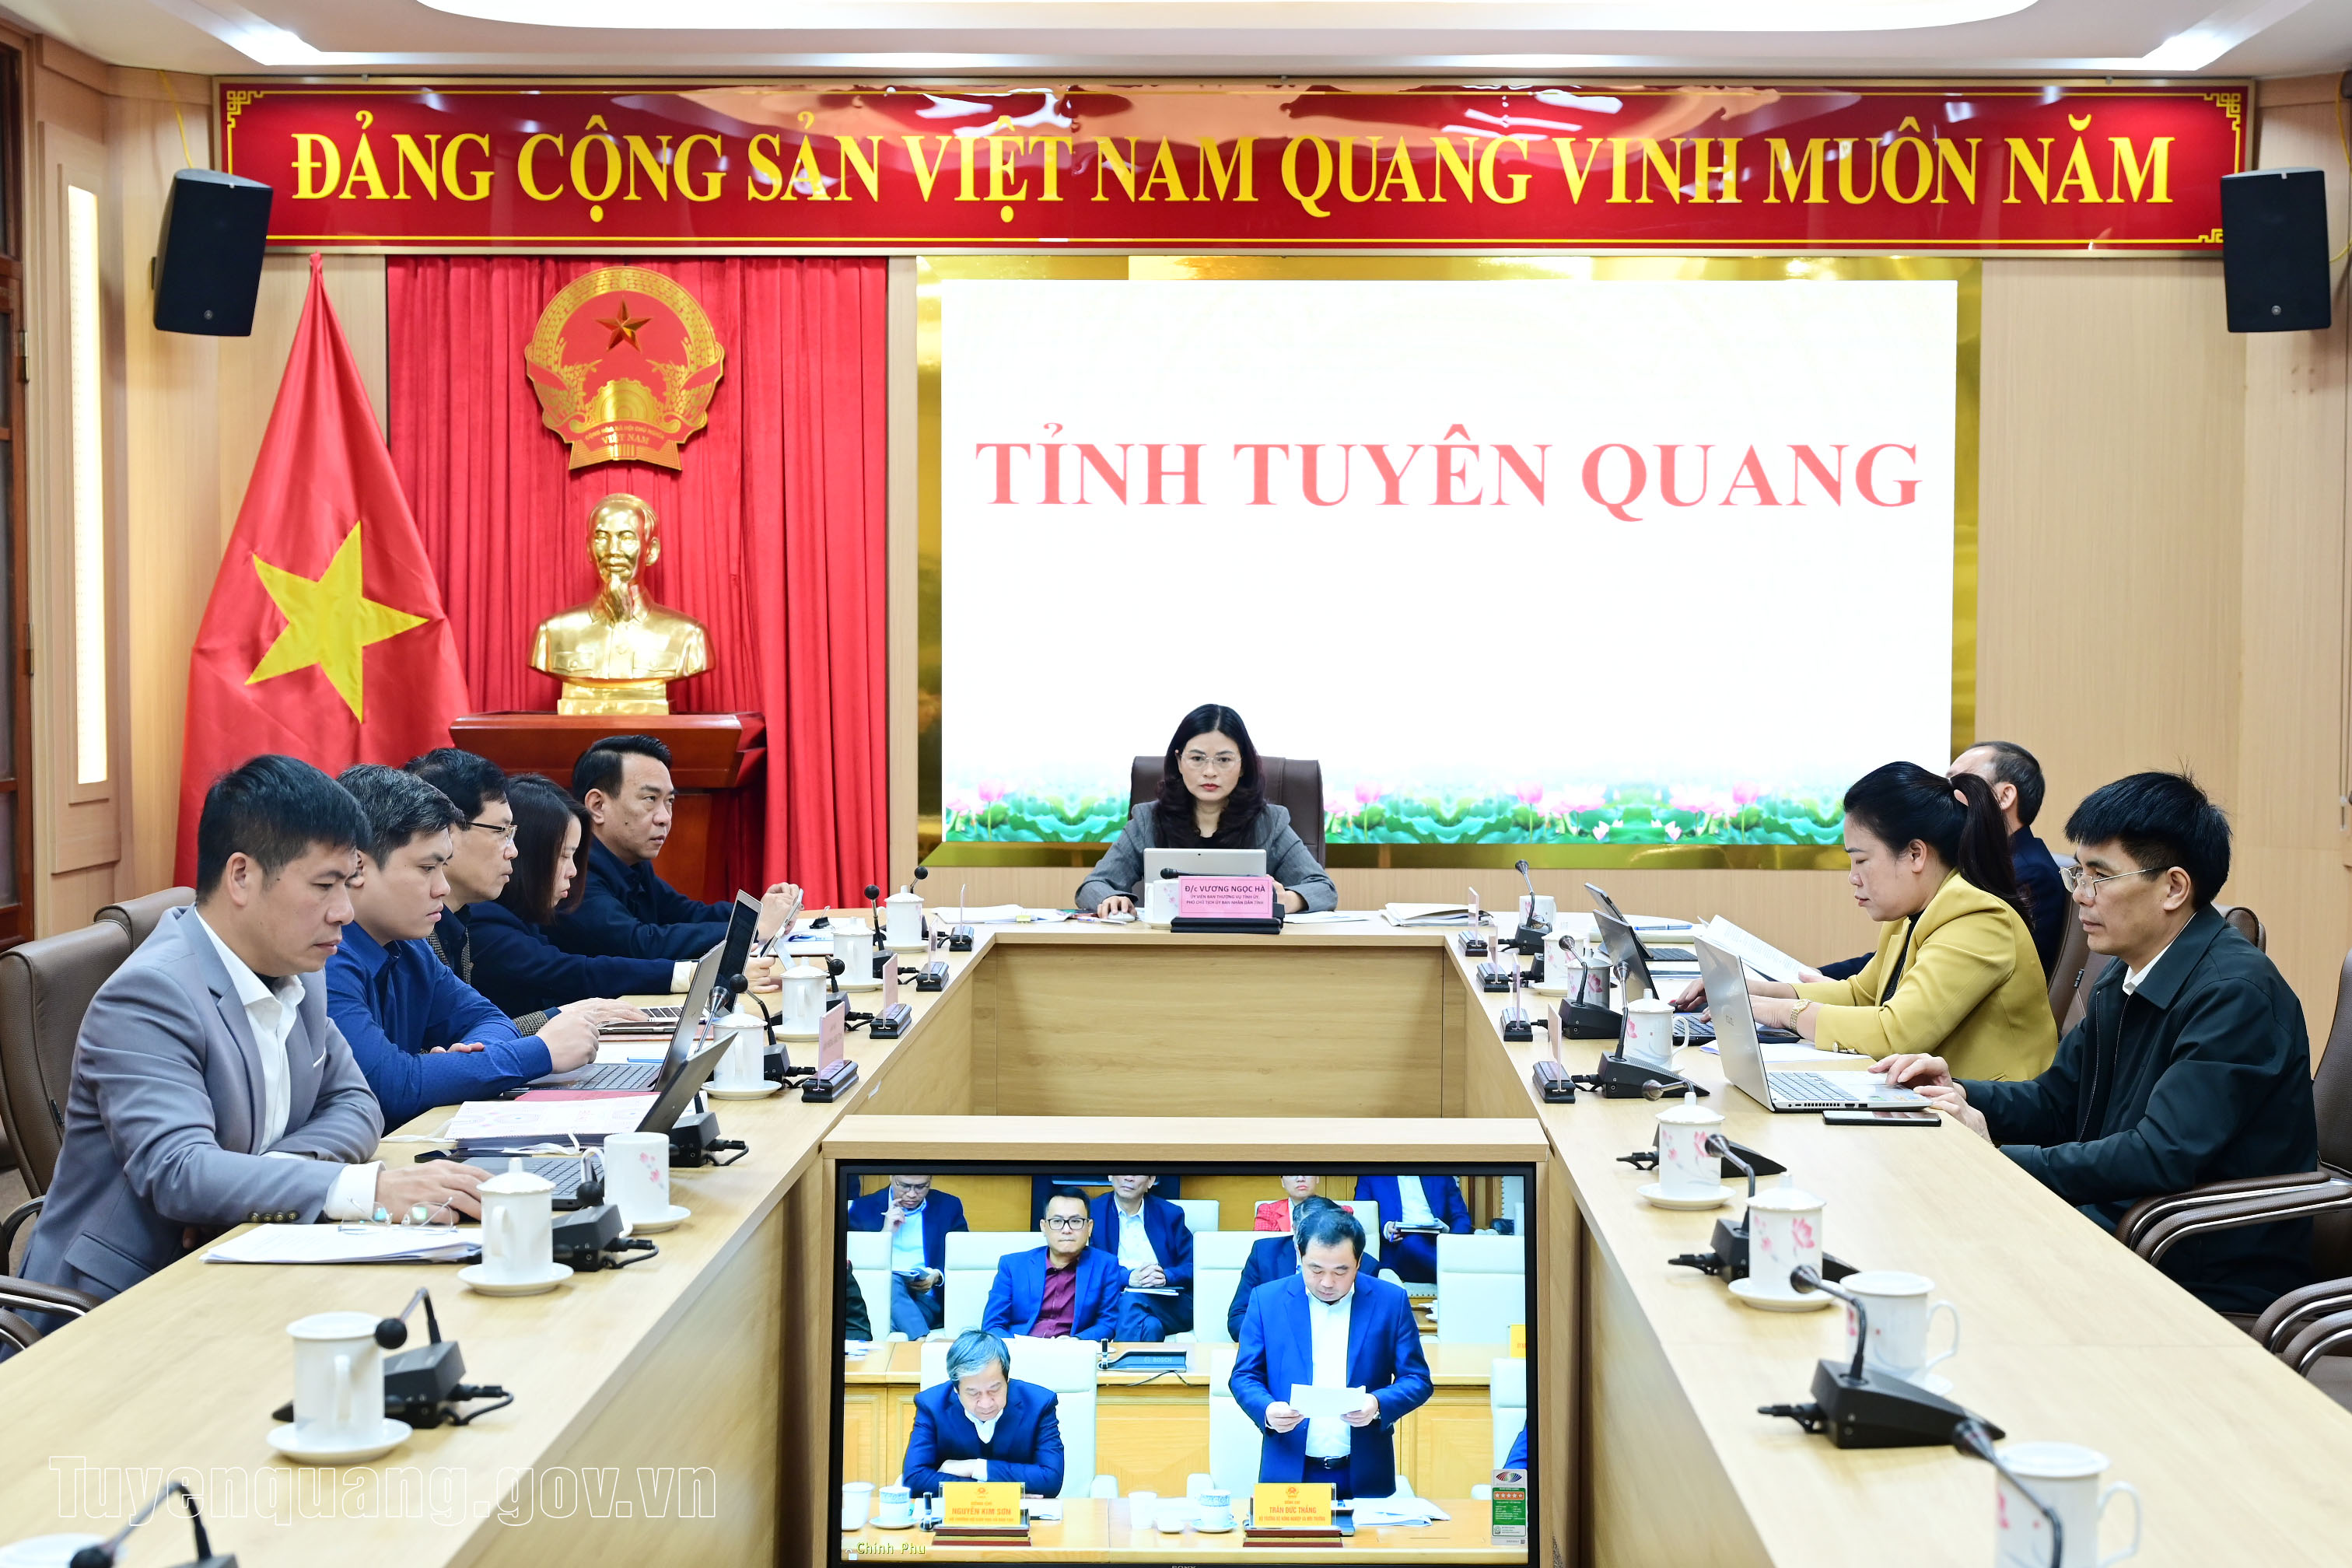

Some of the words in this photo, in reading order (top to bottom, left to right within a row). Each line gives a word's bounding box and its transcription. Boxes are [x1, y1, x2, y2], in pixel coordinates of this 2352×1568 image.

[291, 110, 495, 201] ĐẢNG
[517, 114, 726, 222] CỘNG
[747, 110, 884, 202] SẢN
[901, 115, 1073, 223] VIỆT
[1090, 135, 1259, 203] NAM
[1280, 135, 1532, 219] QUANG
[1552, 137, 1744, 205] VINH
[1763, 116, 1983, 205] MUÔN
[2003, 114, 2176, 205] NĂM
[627, 434, 649, 444] NAM
[976, 423, 1206, 505] TỈNH
[1234, 424, 1552, 506] TUYÊN
[1582, 444, 1922, 522] QUANG
[857, 1542, 894, 1555] Chinh
[901, 1542, 926, 1555] Phu
